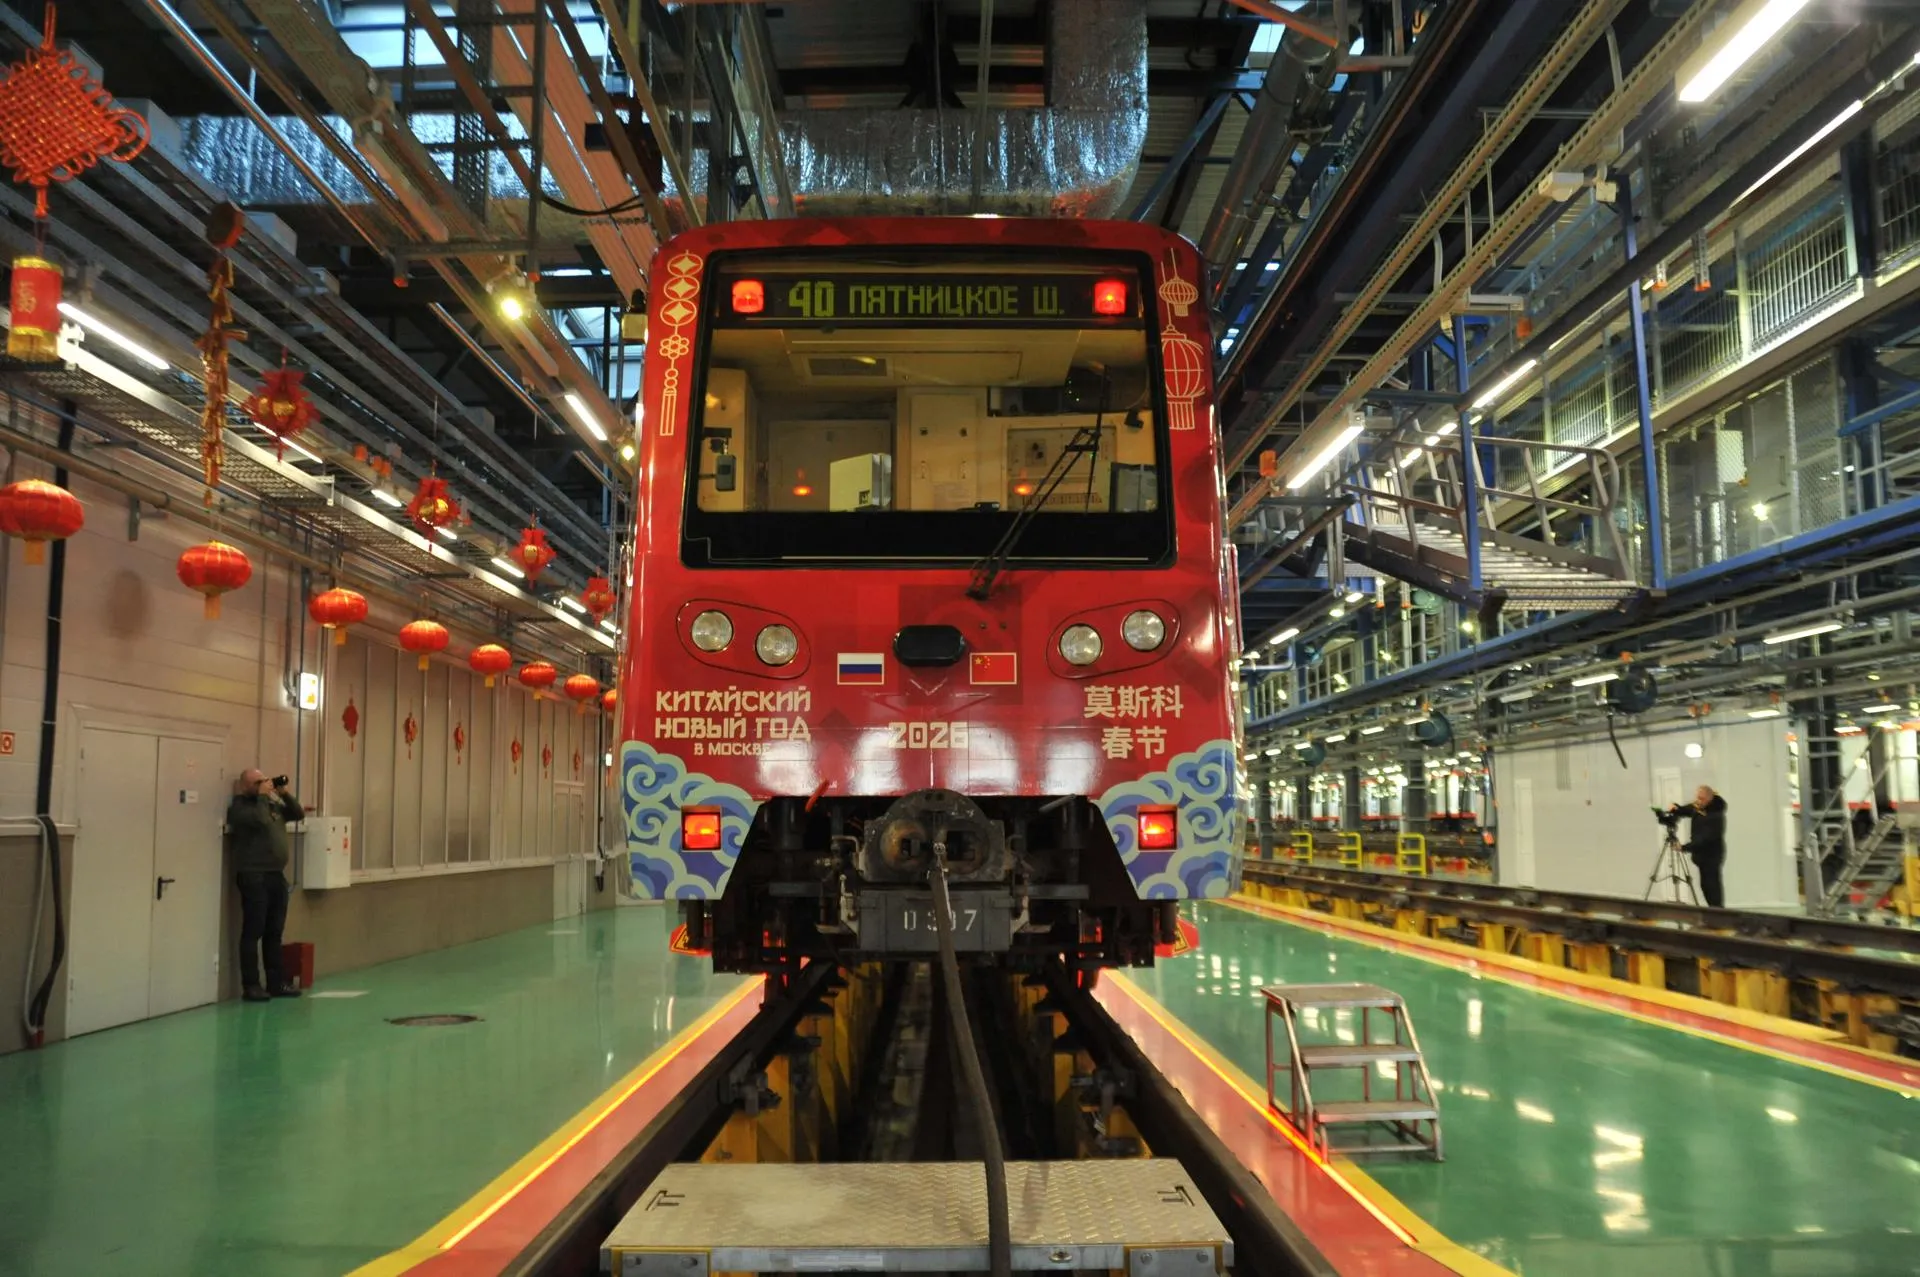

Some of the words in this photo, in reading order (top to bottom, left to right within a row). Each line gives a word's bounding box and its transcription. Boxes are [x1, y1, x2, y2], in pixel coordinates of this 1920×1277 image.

[789, 280, 835, 317] 40
[849, 285, 1019, 316] ПЯТНИЦКОЕ
[1033, 285, 1065, 315] Ш.
[655, 685, 812, 713] КИТАЙСКИЙ
[1084, 685, 1184, 719] 莫斯科
[654, 713, 747, 739] НОВЫЙ
[755, 716, 812, 742] ГОД
[889, 722, 968, 749] 2026
[693, 743, 704, 756] В
[708, 743, 772, 756] МОСКВЕ
[1102, 726, 1168, 760] 春节
